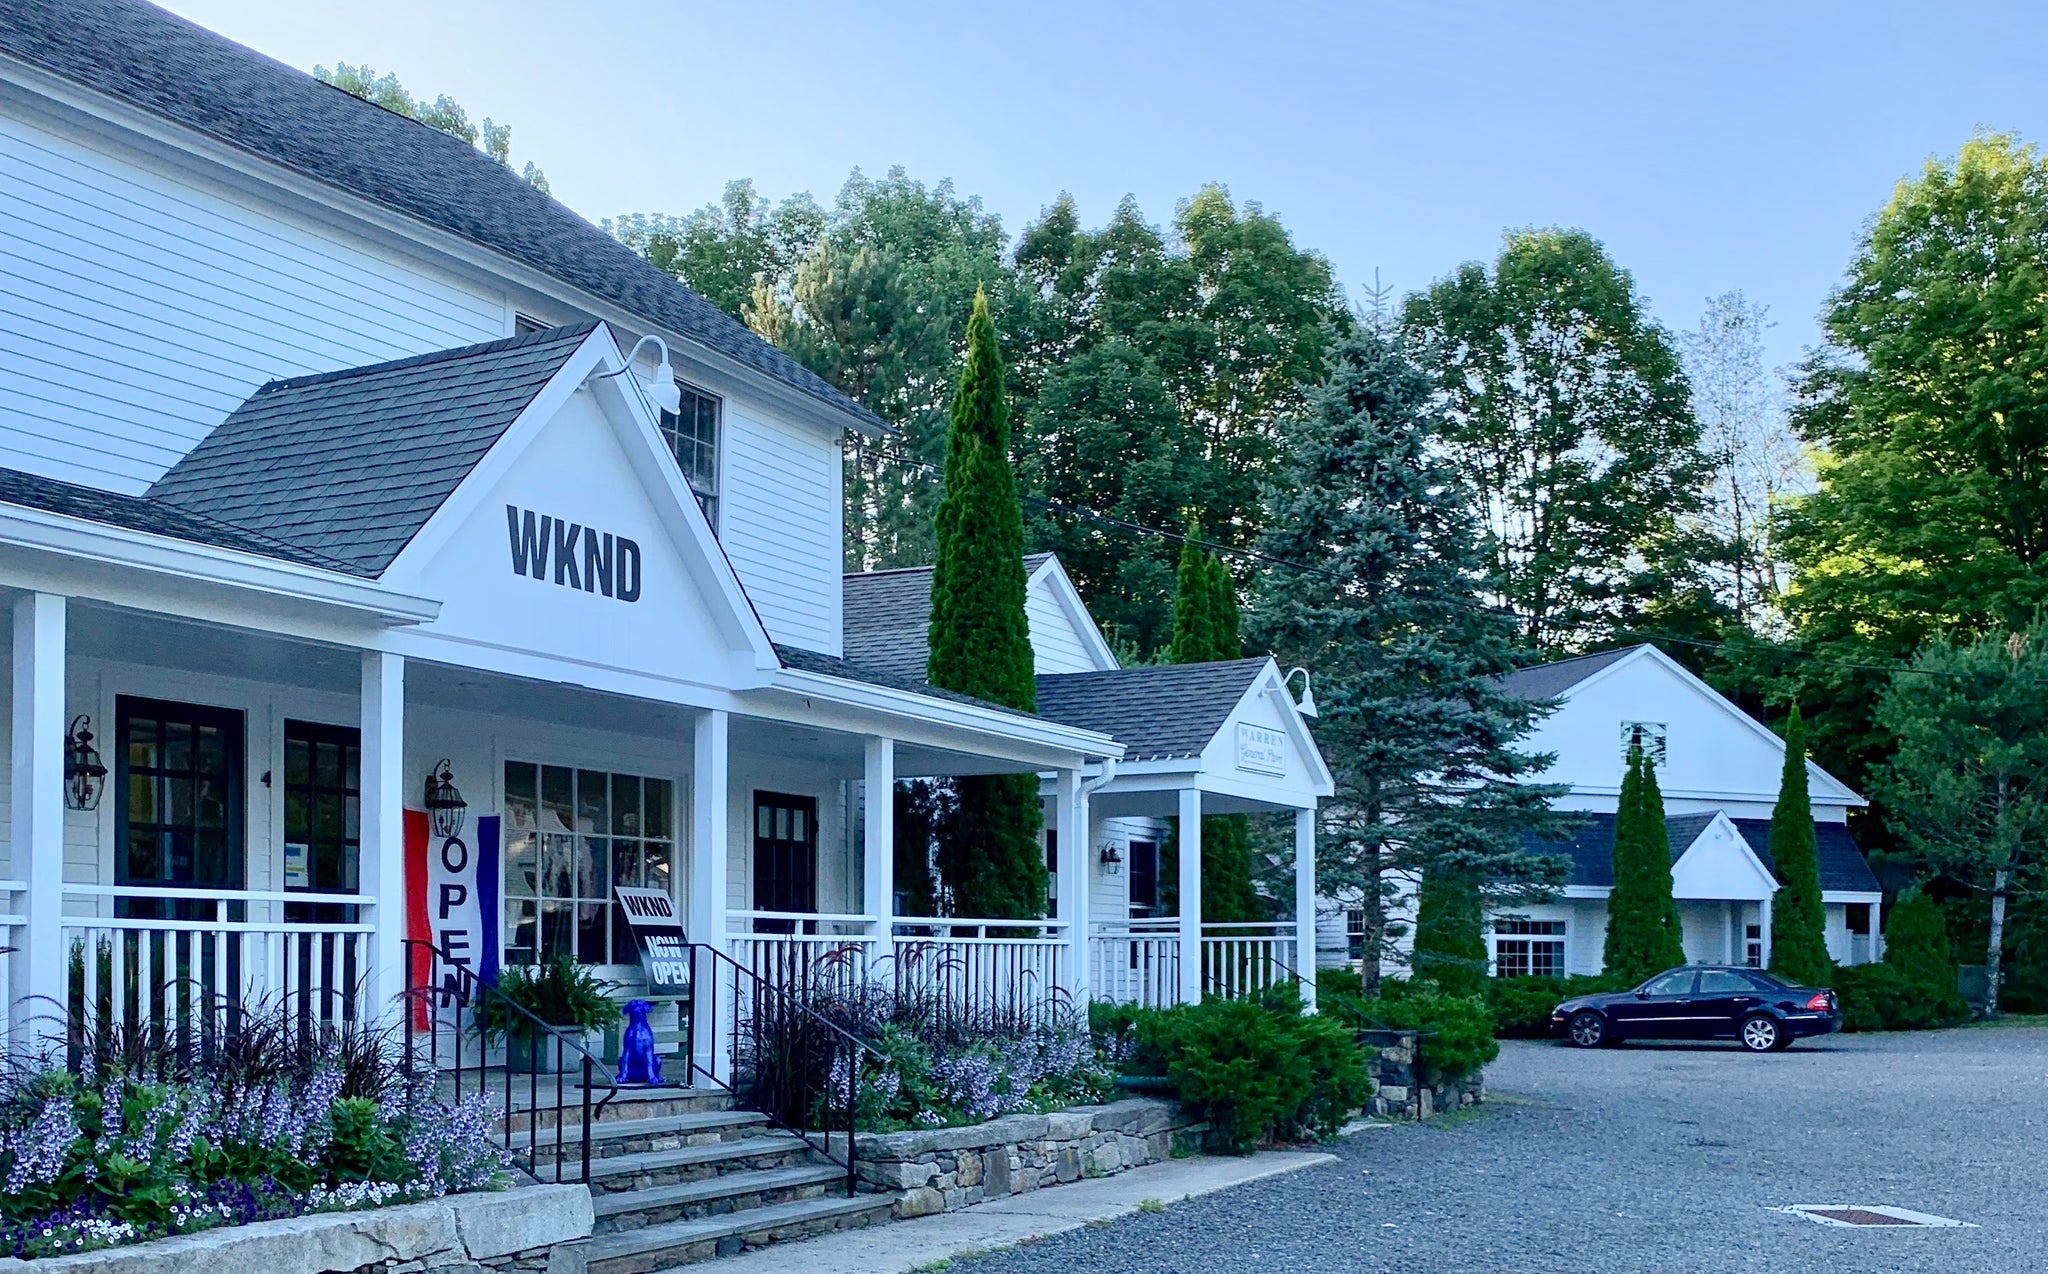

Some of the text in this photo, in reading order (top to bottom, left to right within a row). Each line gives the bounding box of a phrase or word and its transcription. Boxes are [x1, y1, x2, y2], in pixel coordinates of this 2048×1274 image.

[506, 504, 641, 603] WKND
[1240, 727, 1283, 746] WARREN
[623, 895, 673, 918] WKND
[439, 836, 471, 1008] OPEN
[644, 935, 682, 959] NOW
[651, 961, 690, 985] OPEN
